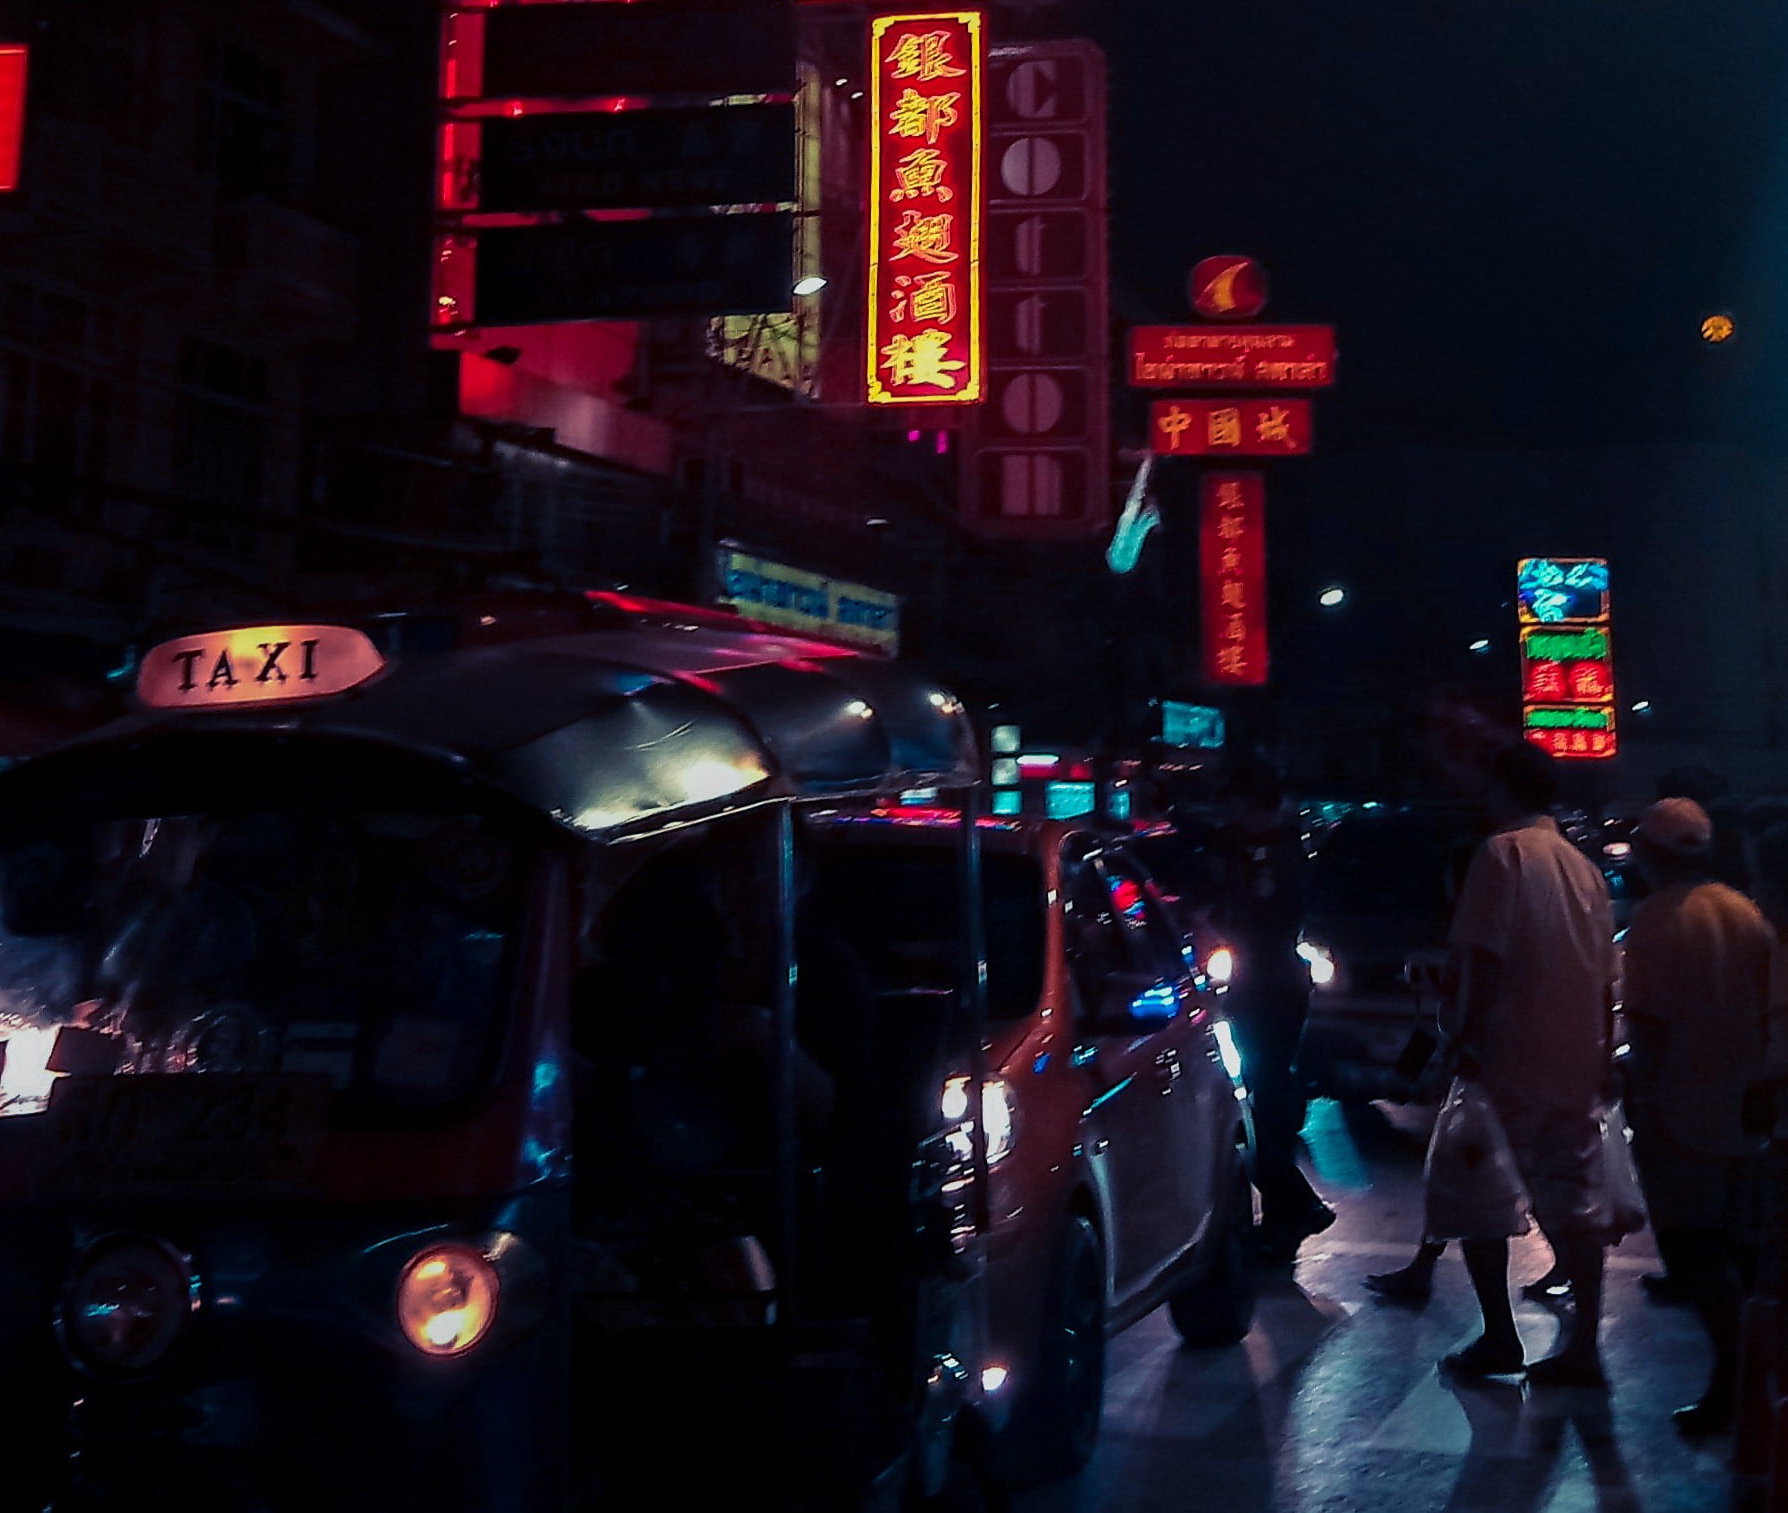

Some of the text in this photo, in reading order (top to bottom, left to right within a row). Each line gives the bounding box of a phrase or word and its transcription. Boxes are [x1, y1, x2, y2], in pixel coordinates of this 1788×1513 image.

[881, 30, 967, 389] 銀都魚翅酒樓
[1158, 405, 1298, 450] 中國城
[172, 638, 320, 691] TAXI
